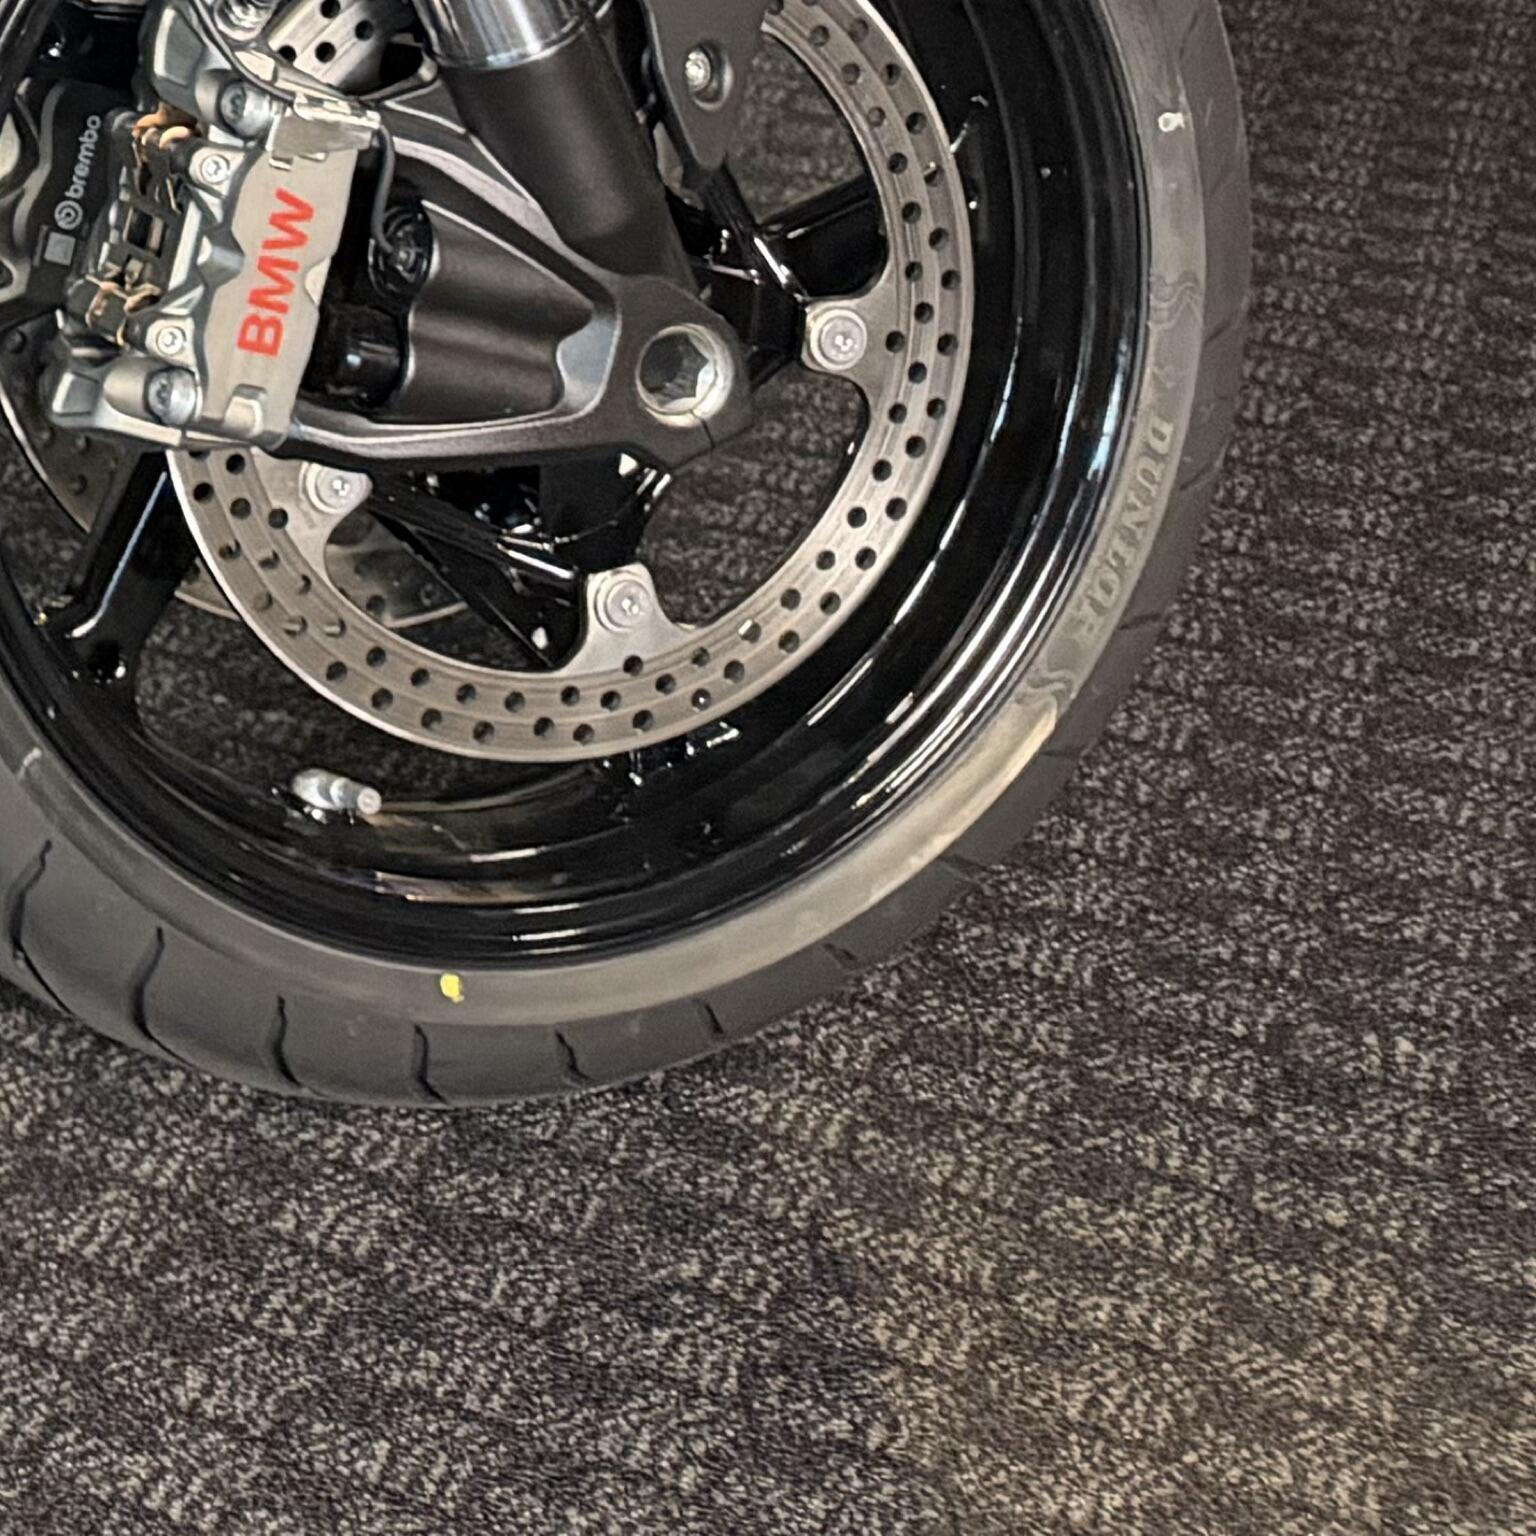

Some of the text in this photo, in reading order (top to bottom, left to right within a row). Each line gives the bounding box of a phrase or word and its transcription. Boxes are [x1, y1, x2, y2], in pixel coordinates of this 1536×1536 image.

[64, 113, 103, 201] brembo
[236, 186, 316, 359] BMW
[1078, 416, 1175, 638] DUNLOP
